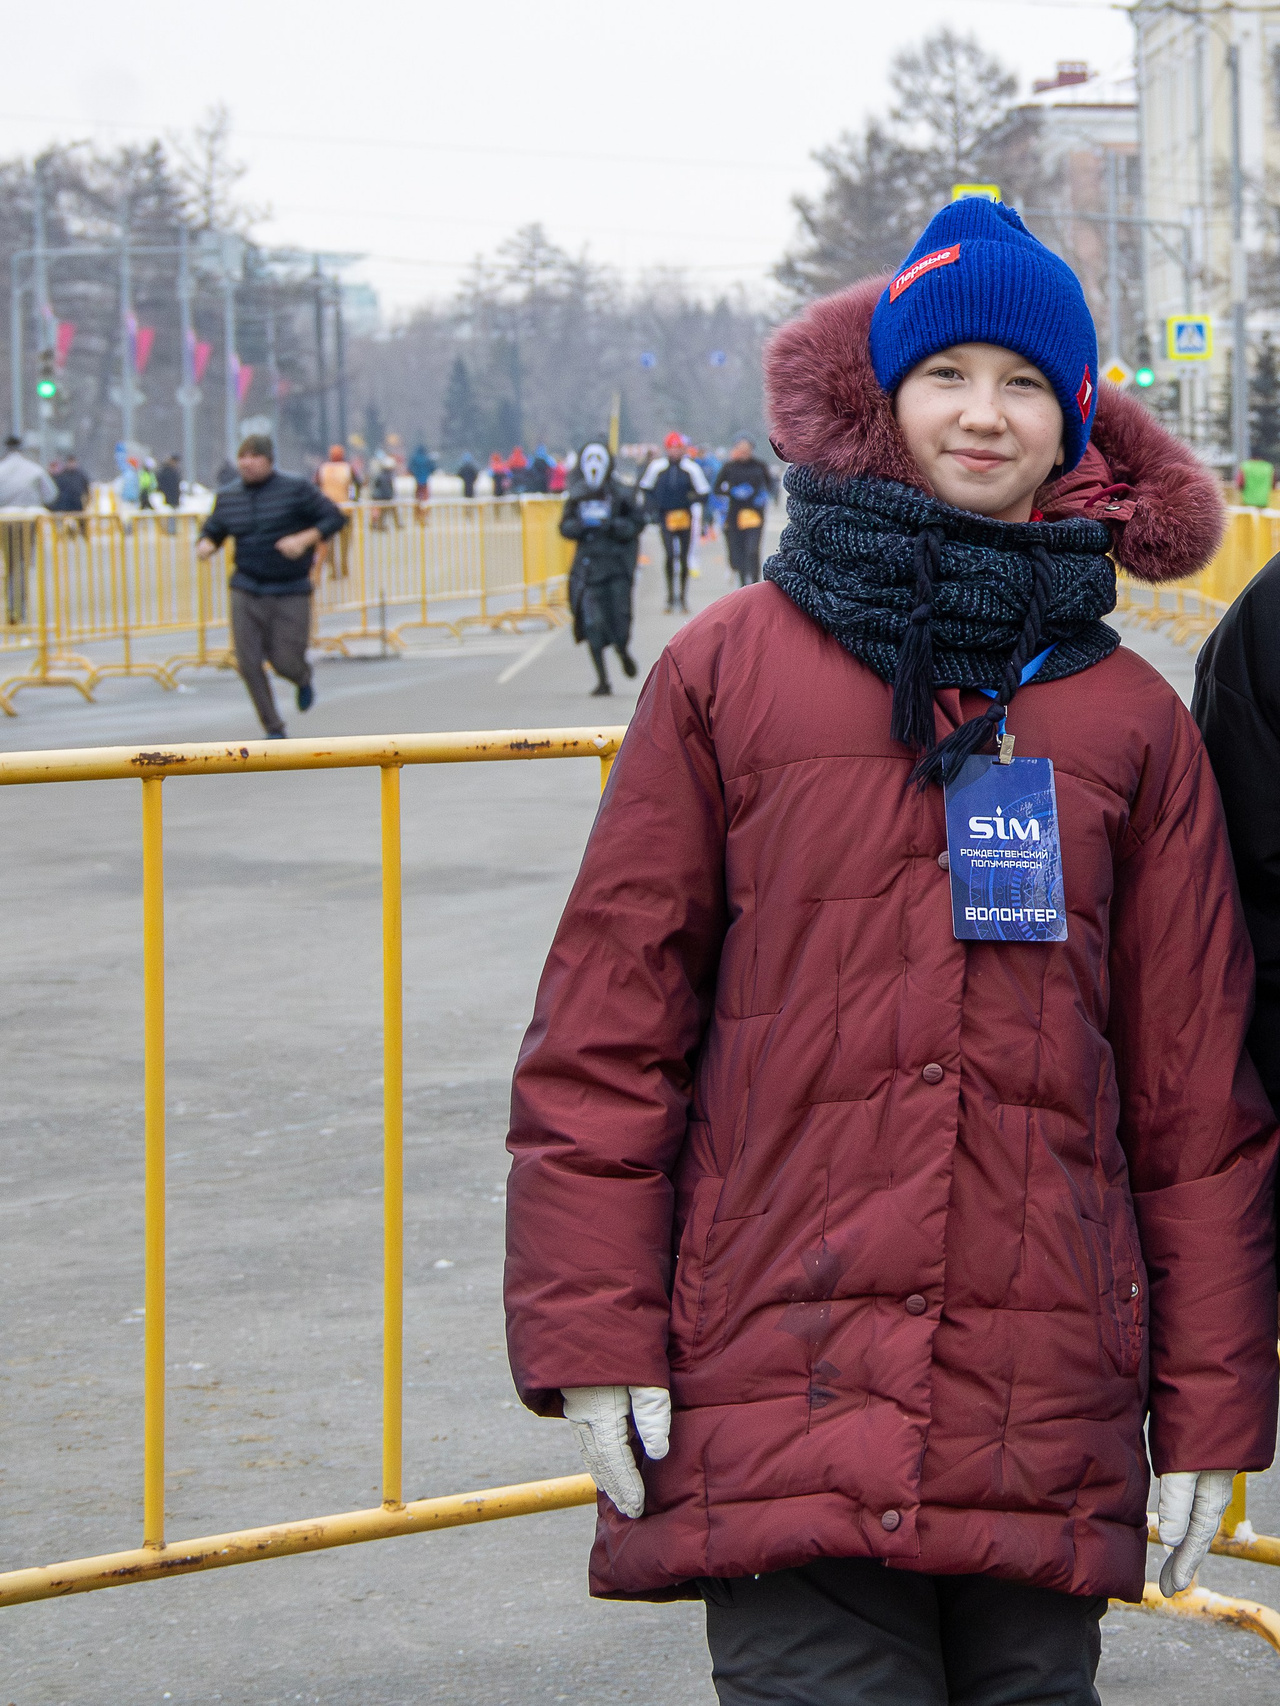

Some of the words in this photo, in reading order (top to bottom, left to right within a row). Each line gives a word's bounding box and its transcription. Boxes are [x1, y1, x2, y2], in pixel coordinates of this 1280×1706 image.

[895, 252, 951, 289] Первые
[960, 848, 1049, 860] РОЖДЕСТВЕНСКИЙ
[971, 859, 1043, 870] ПОЛУМАРАФОН
[965, 907, 1057, 922] ВОЛОНТЕР
